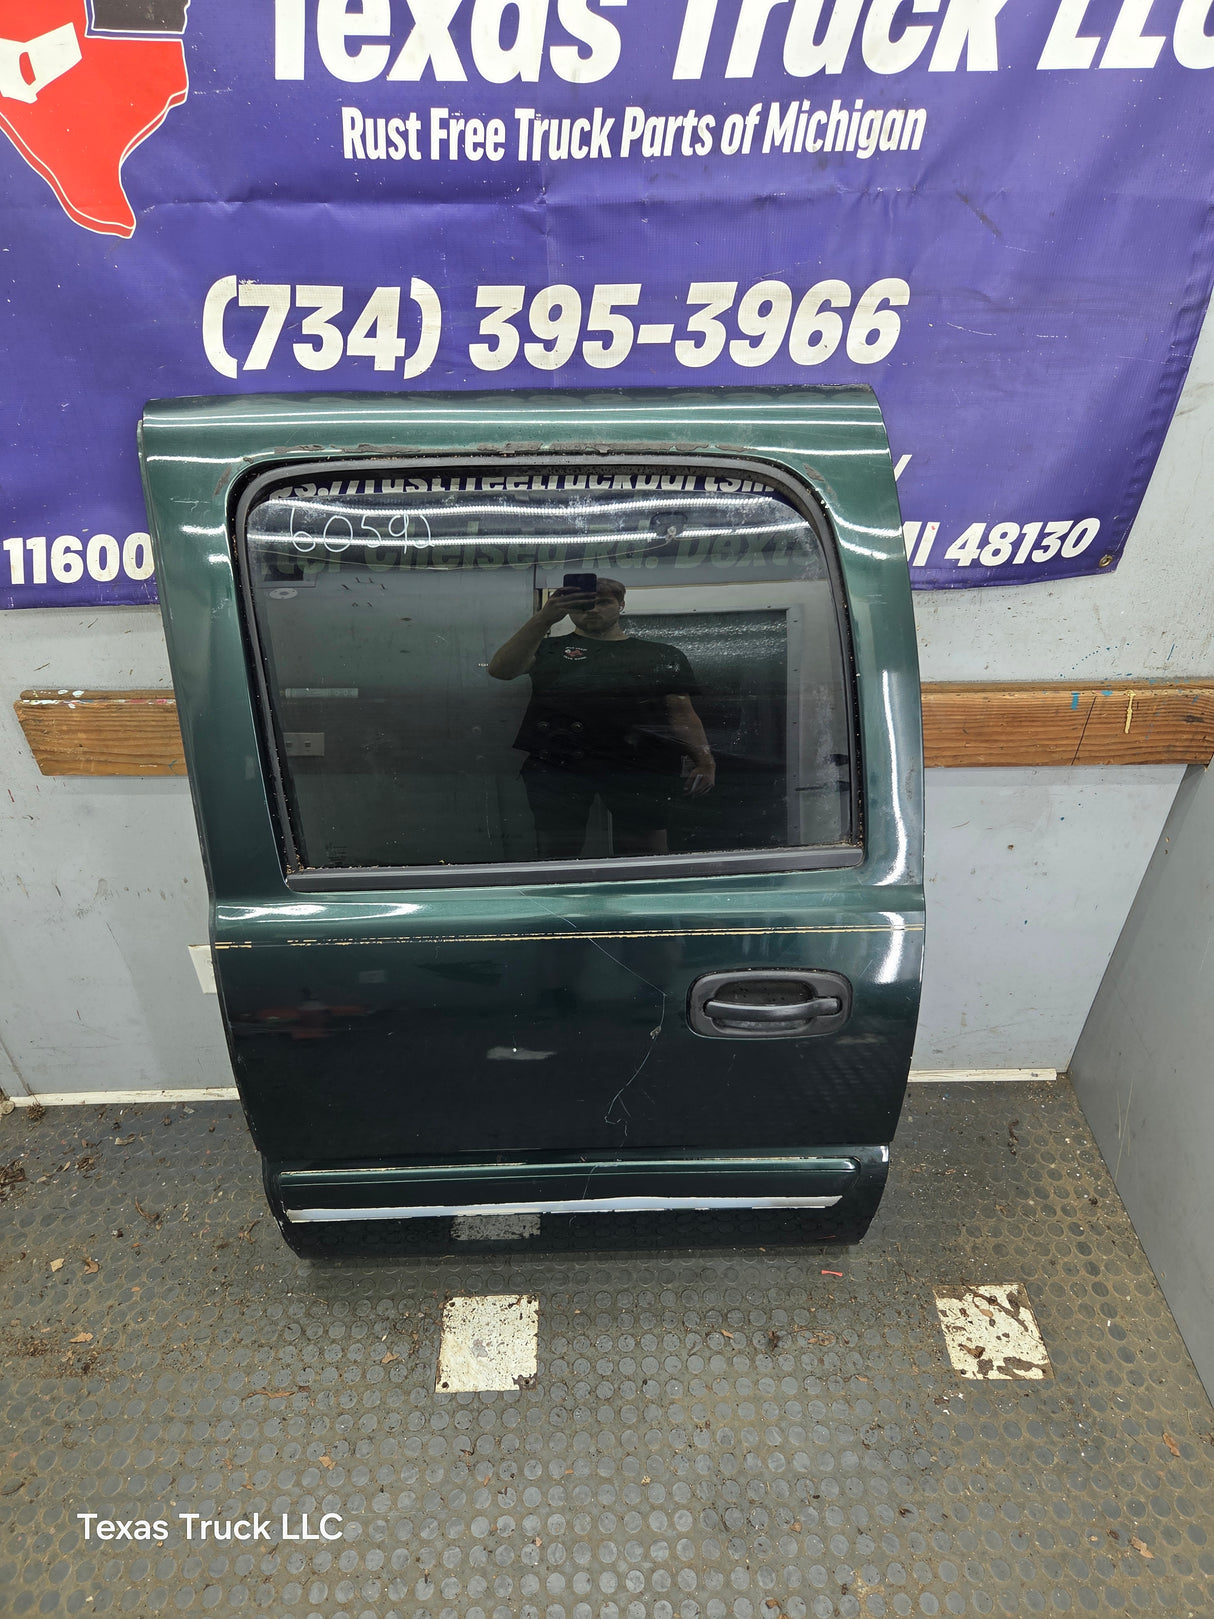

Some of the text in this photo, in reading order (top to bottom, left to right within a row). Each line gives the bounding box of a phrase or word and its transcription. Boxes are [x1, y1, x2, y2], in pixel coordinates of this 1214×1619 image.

[341, 98, 927, 162] Rust Free Truck Parts of Michigan
[202, 275, 911, 379] (734) 395-3966
[2, 532, 156, 585] 11600
[944, 517, 1101, 567] 48130
